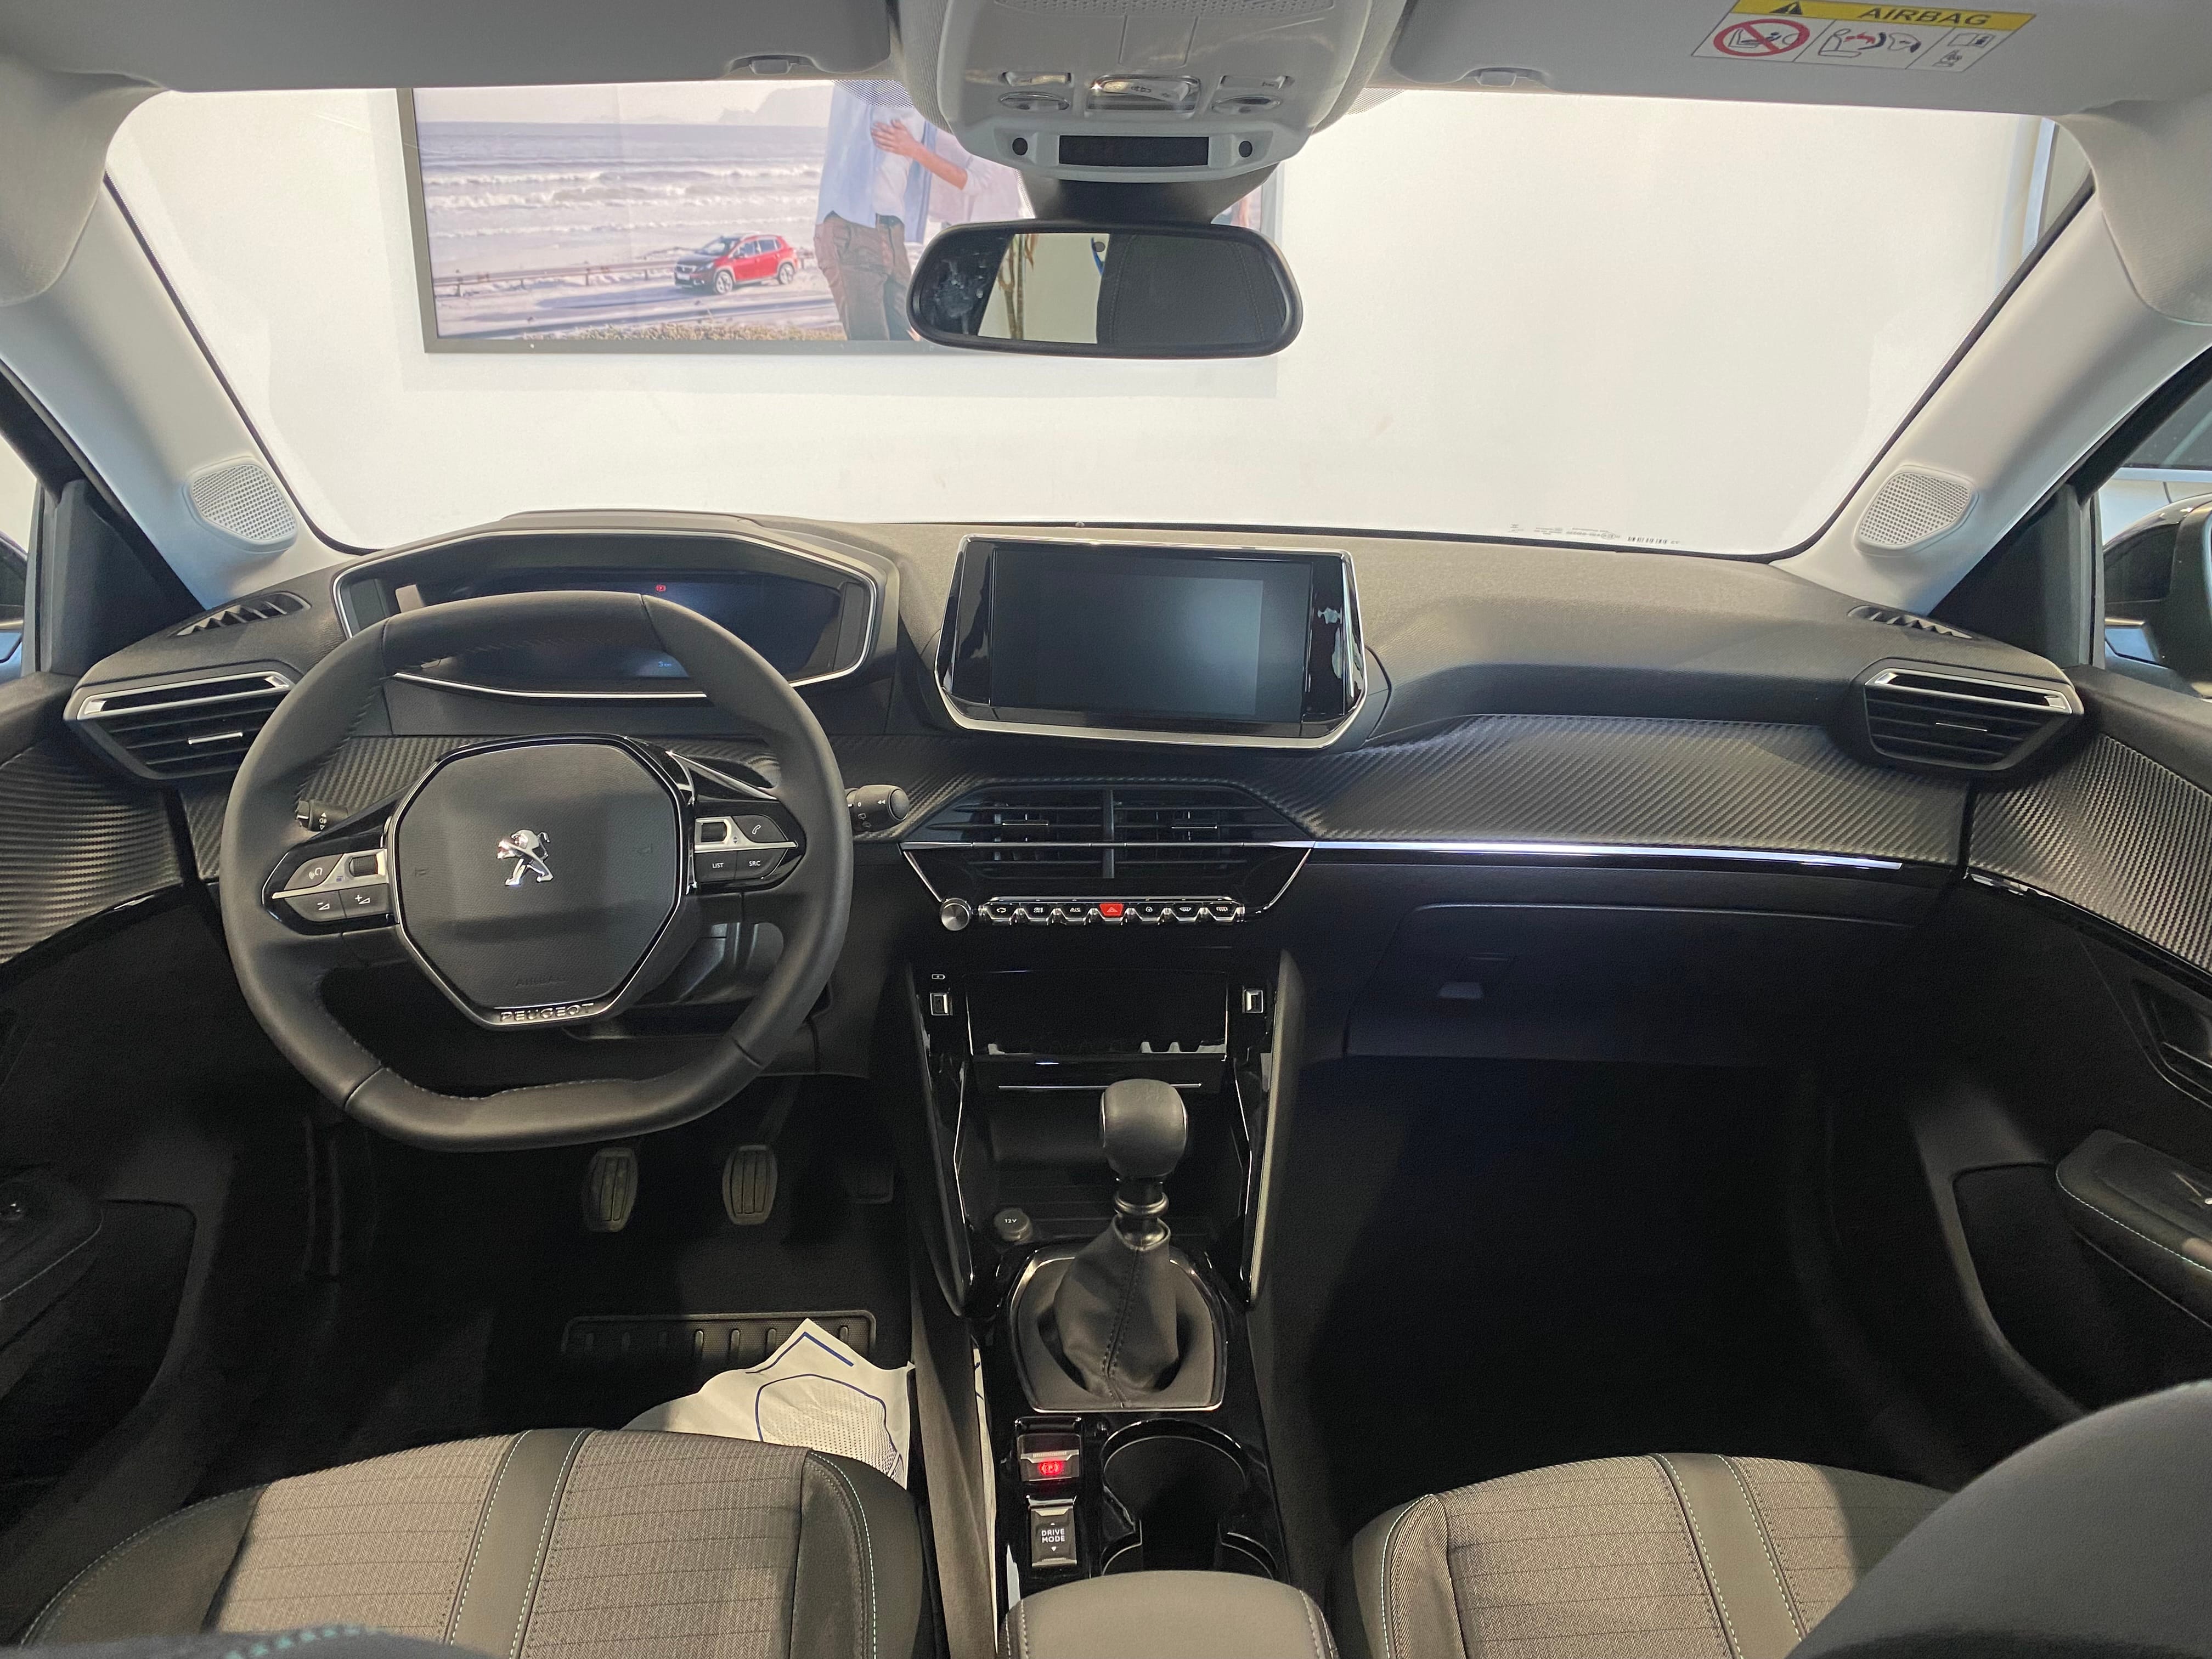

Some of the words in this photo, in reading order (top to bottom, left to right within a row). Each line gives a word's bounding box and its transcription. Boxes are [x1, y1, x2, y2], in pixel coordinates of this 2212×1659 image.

[1857, 8, 1991, 25] AIRBAG
[500, 1002, 594, 1022] PEUGEOT
[1041, 1528, 1065, 1537] DRIVE
